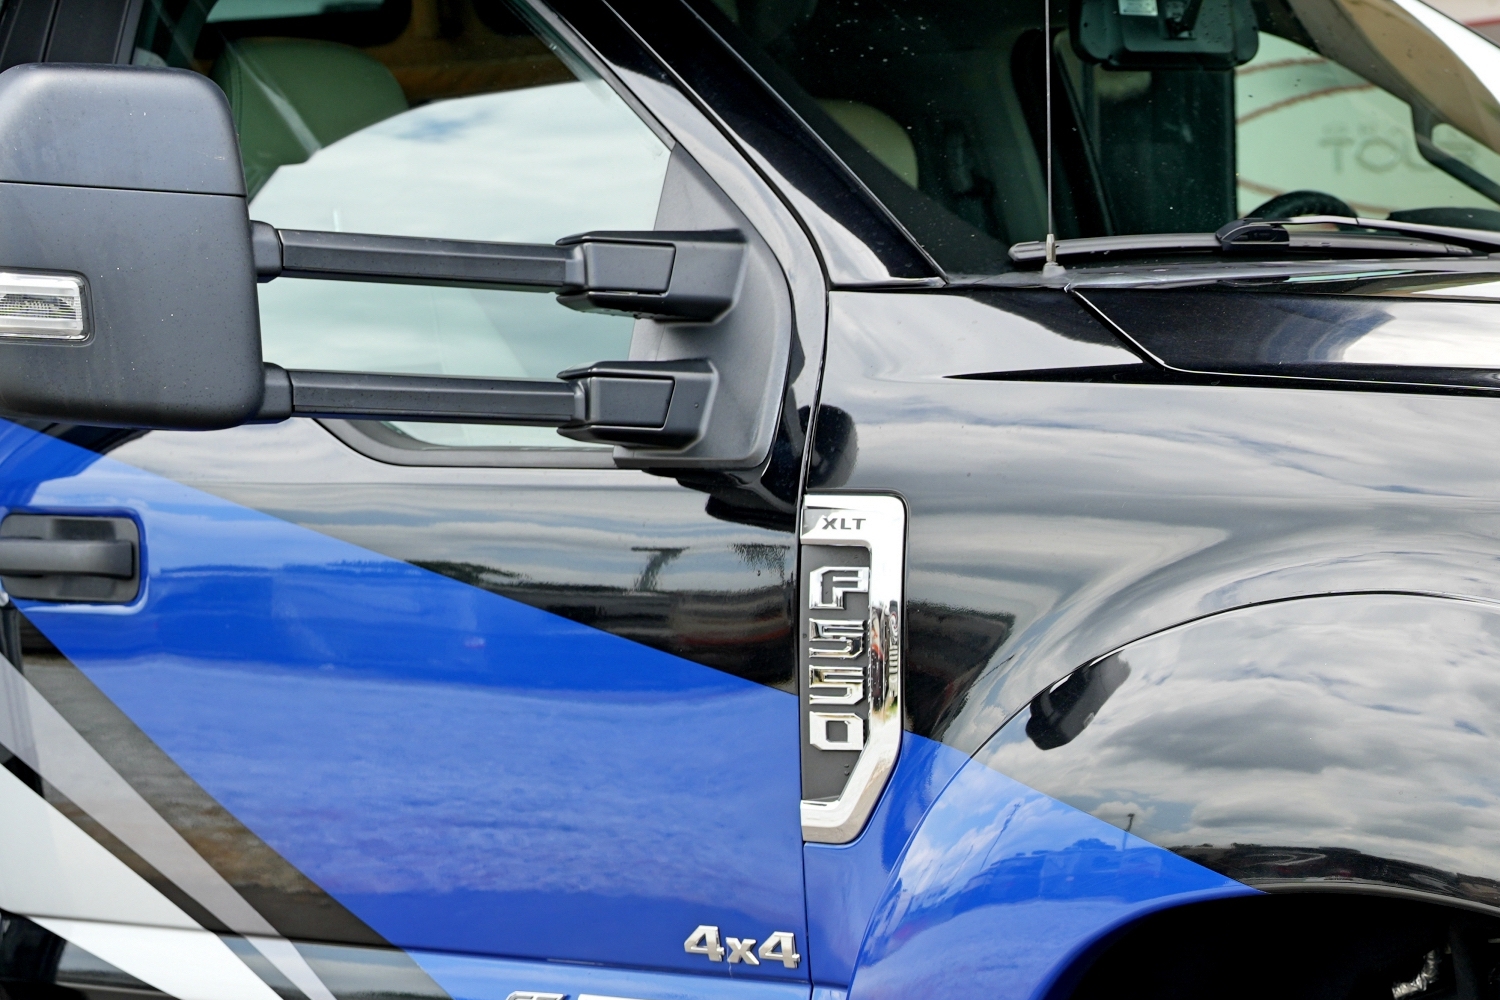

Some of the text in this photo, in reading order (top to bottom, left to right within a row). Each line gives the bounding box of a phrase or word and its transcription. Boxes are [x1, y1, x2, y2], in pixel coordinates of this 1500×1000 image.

[821, 517, 867, 531] XLT
[808, 565, 870, 751] F550
[684, 924, 801, 969] 4x4
